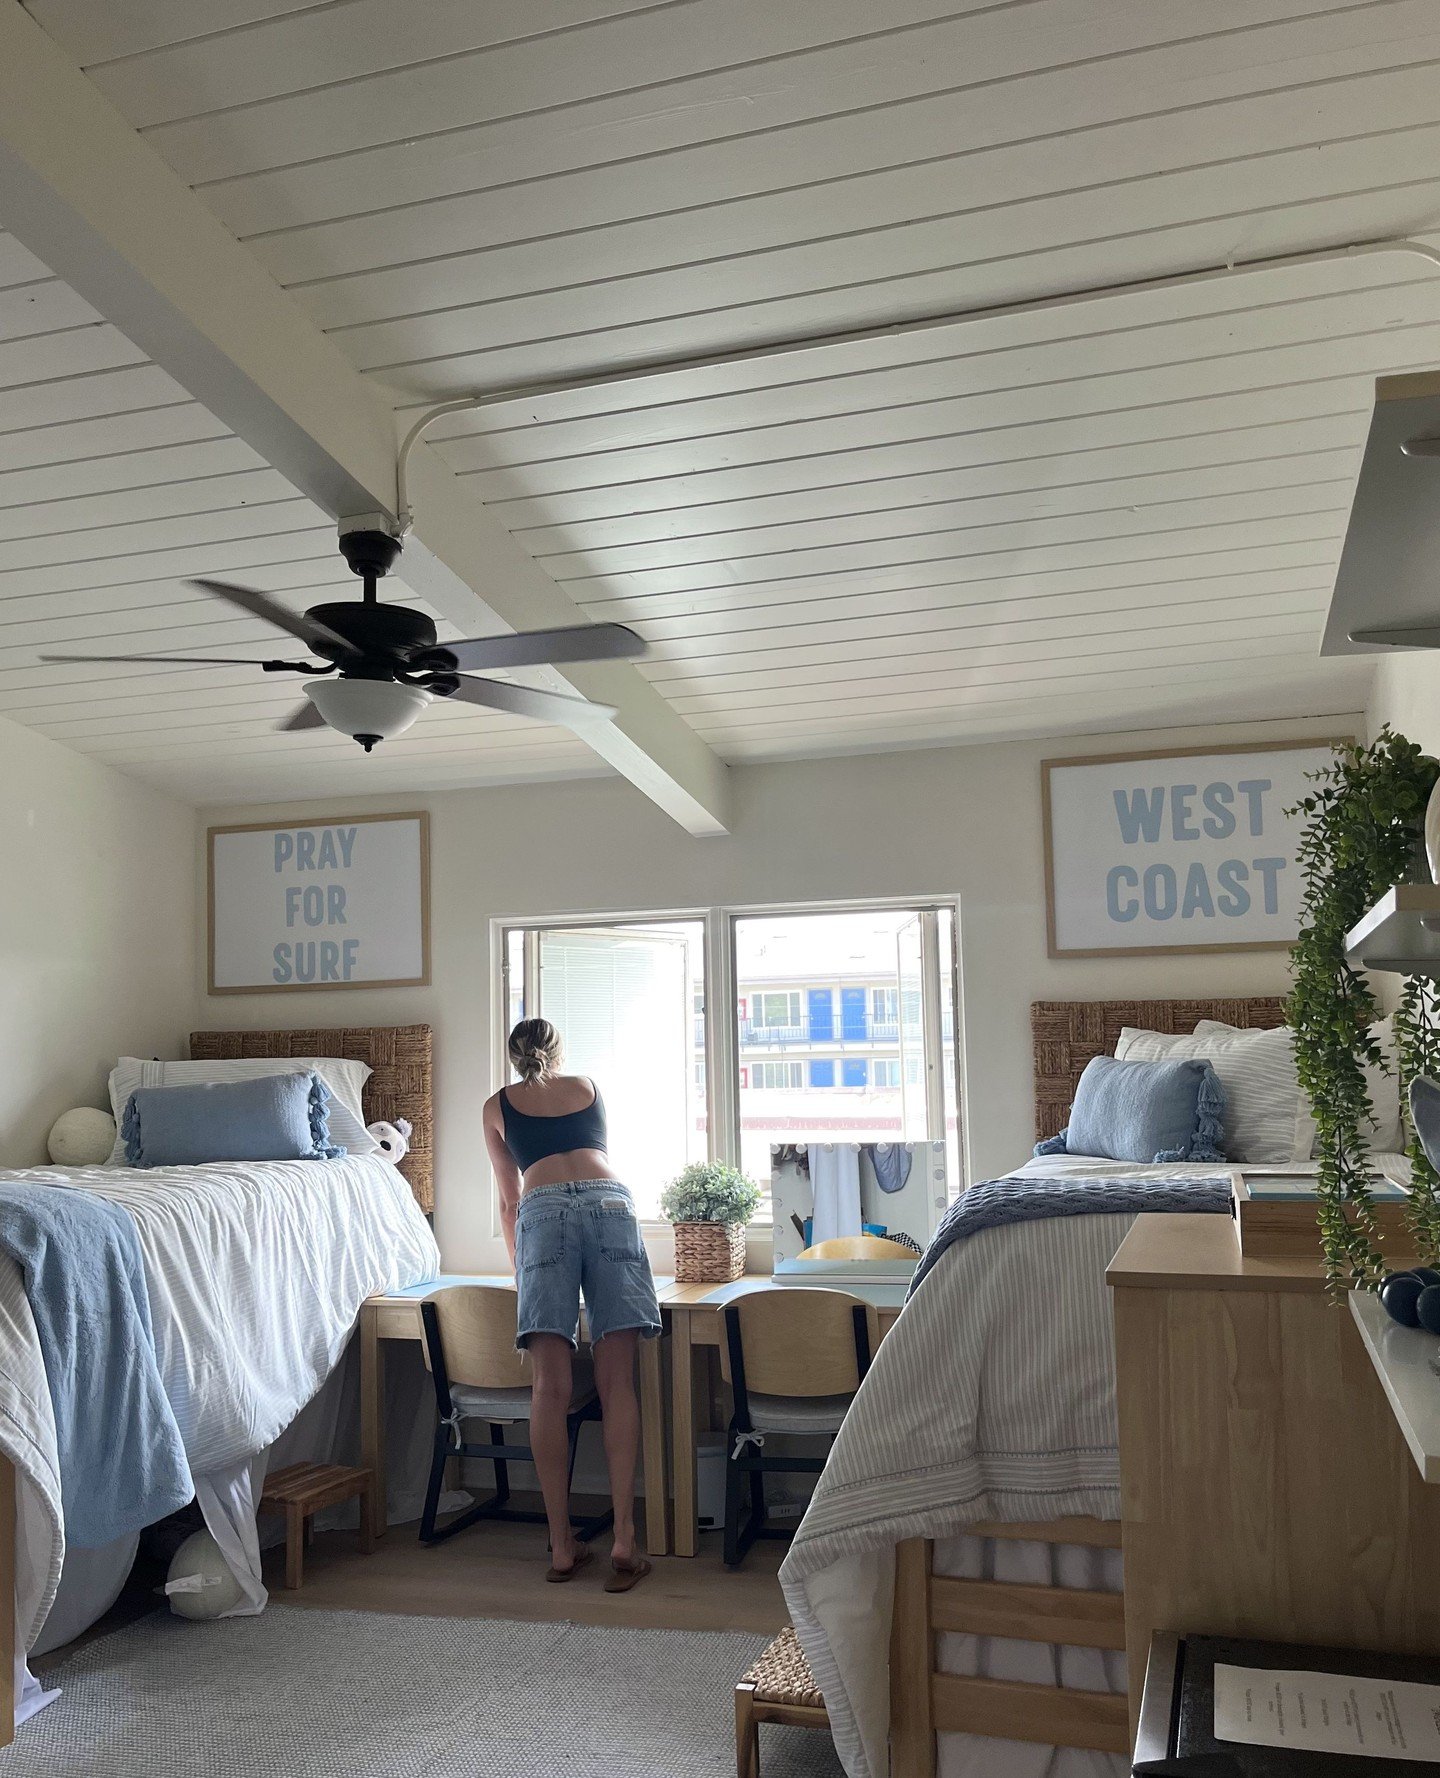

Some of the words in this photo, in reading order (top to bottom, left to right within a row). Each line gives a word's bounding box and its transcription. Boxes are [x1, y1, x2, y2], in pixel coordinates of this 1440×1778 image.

[1113, 779, 1272, 844] WEST
[274, 827, 357, 873] PRAY
[286, 885, 347, 928] FOR
[1106, 857, 1287, 922] COAST
[273, 939, 360, 984] SURF
